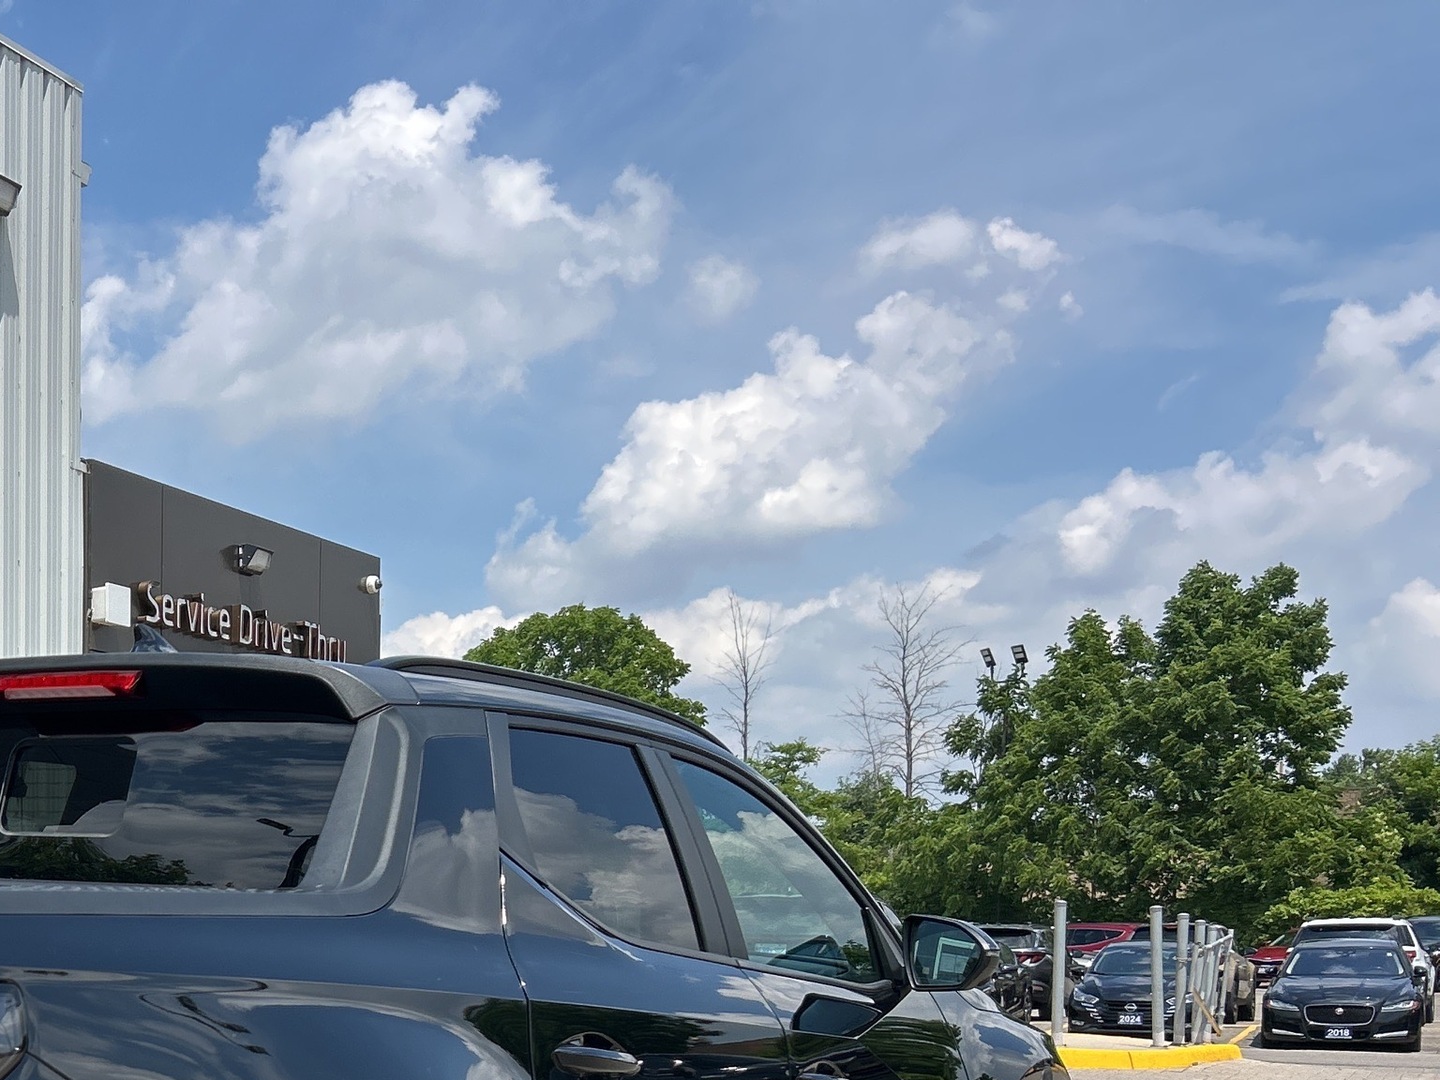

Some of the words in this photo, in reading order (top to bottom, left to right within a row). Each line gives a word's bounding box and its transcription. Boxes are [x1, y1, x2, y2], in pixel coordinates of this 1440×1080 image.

[145, 581, 231, 640] Service
[1119, 1014, 1142, 1024] 2024
[1326, 1027, 1350, 1037] 2018
